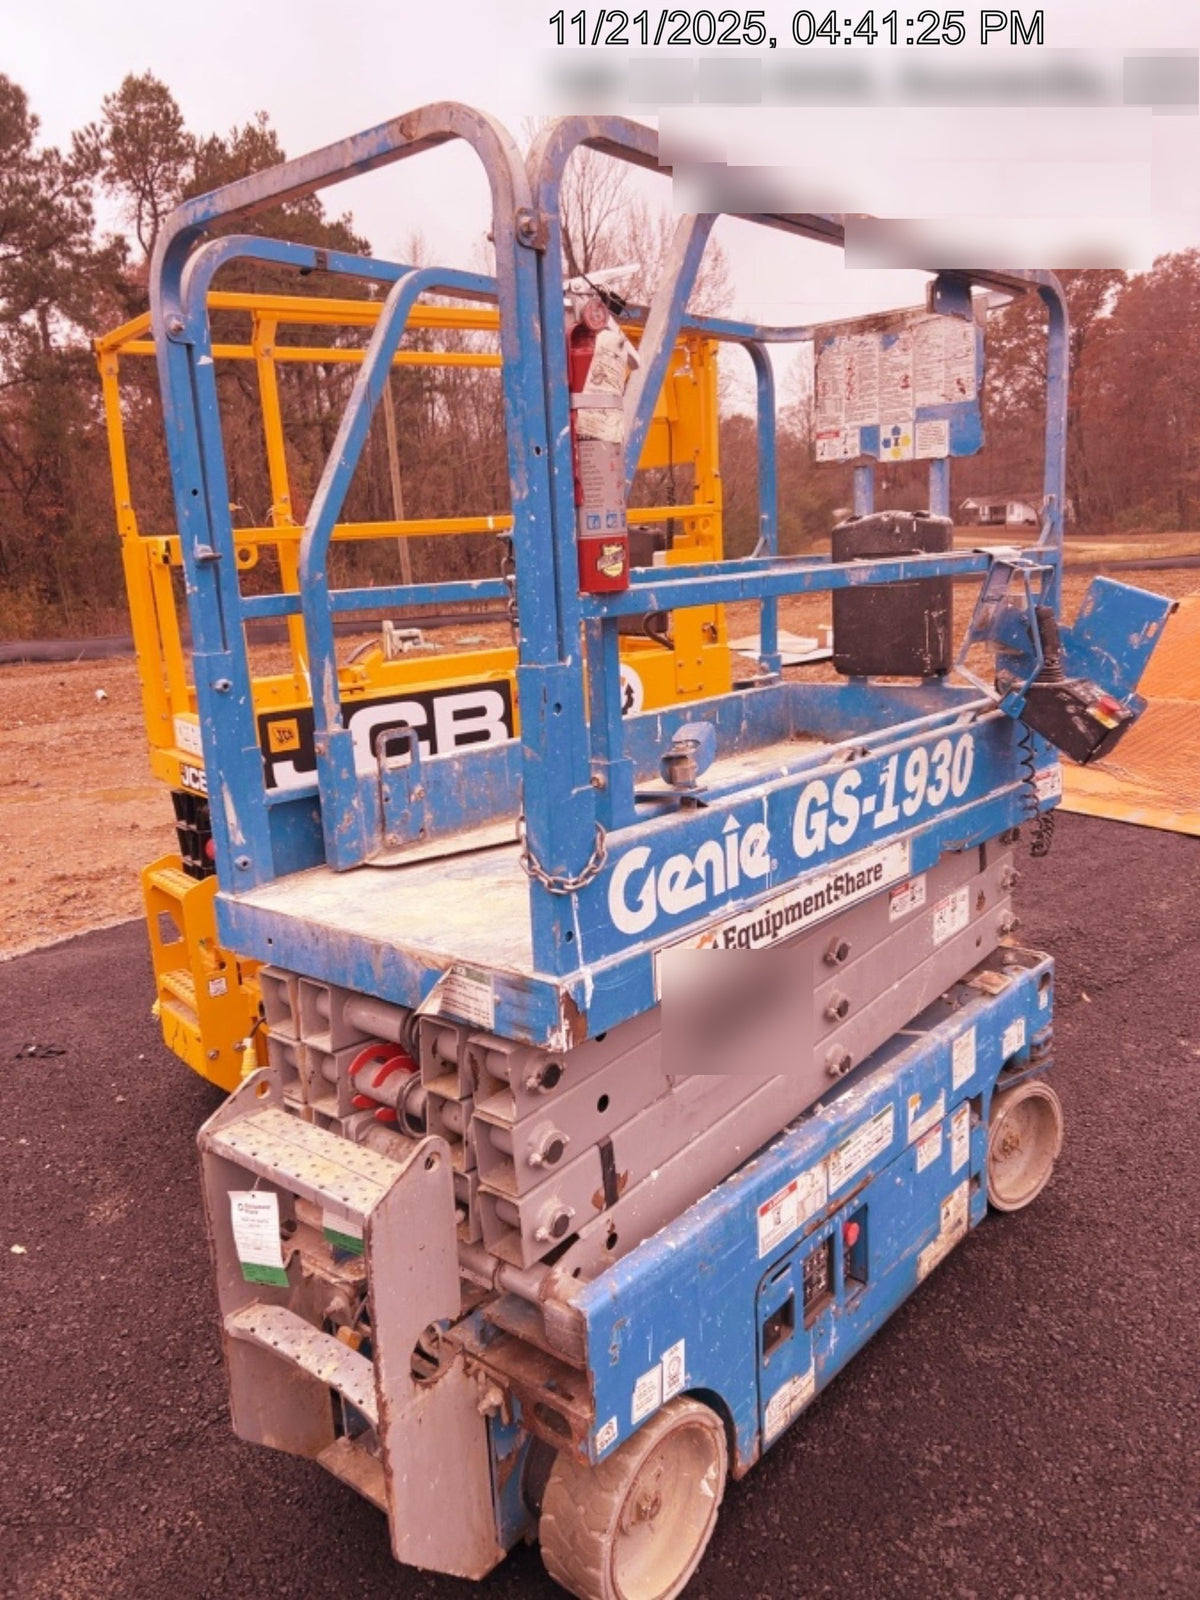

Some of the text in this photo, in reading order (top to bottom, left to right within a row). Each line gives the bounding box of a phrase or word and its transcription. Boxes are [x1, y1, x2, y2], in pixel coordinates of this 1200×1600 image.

[792, 733, 975, 858] GS-1930
[608, 814, 771, 934] Genie
[723, 863, 883, 949] EquipmentShare
